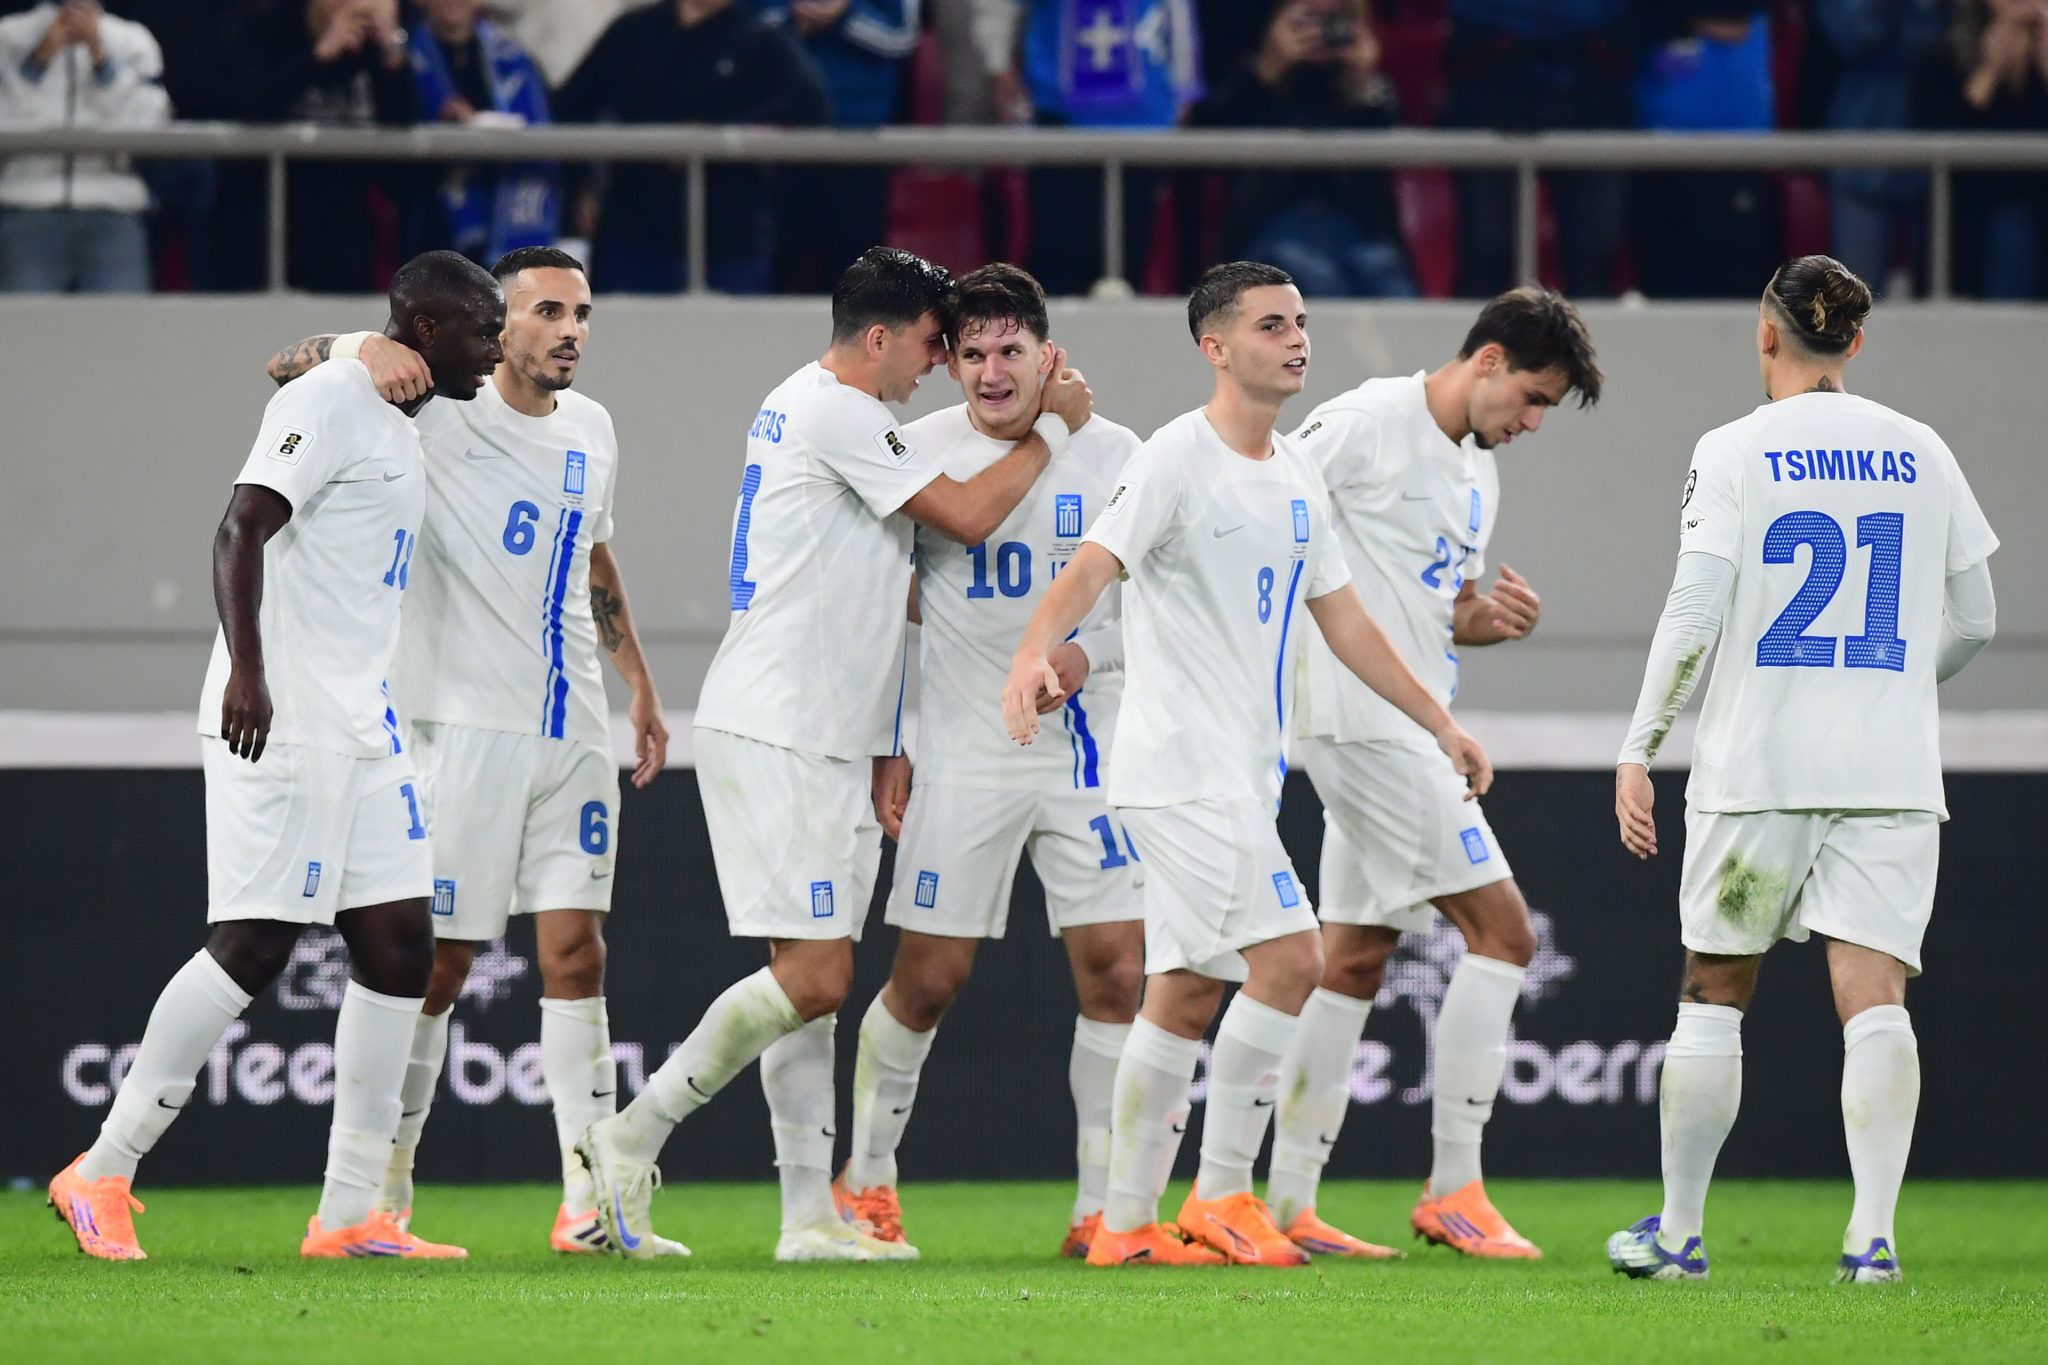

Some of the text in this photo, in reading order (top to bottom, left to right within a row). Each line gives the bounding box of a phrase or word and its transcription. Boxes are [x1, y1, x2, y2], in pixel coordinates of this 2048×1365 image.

[1764, 449, 1917, 484] TSIMIKAS
[502, 500, 541, 556] 6
[967, 542, 1032, 599] 10
[1257, 566, 1275, 624] 8
[1756, 510, 1907, 672] 21
[579, 801, 608, 855] 6
